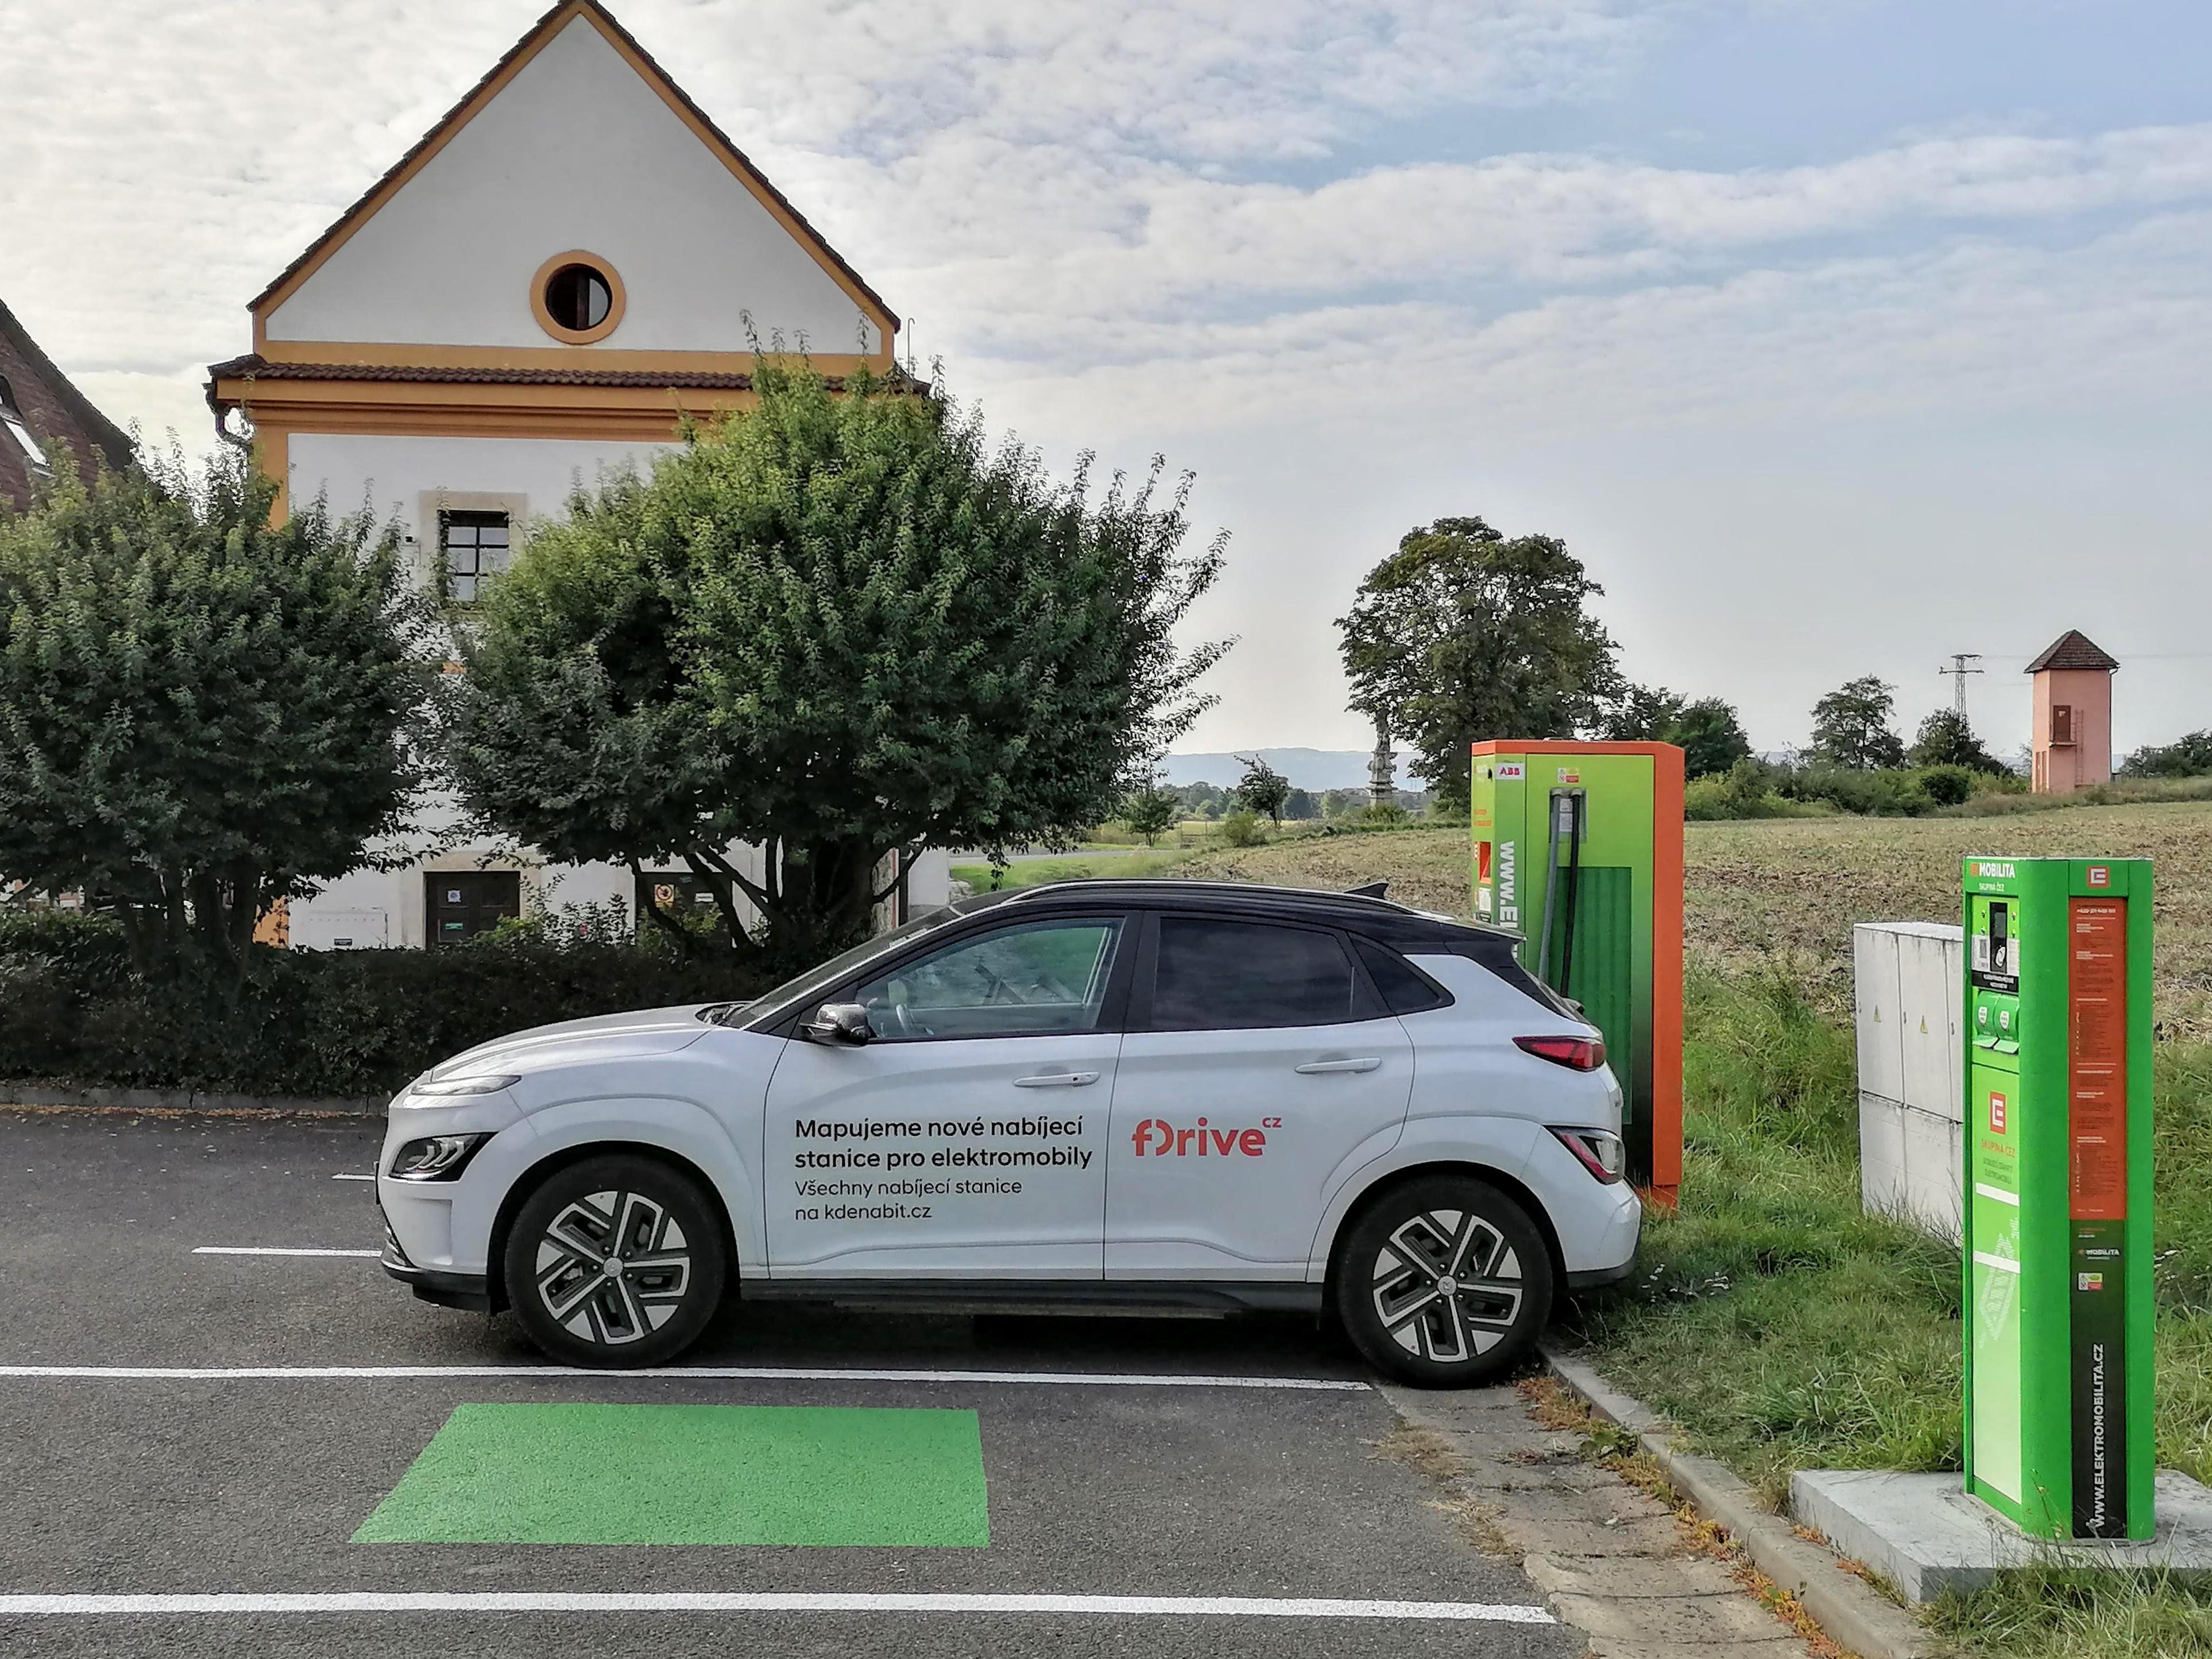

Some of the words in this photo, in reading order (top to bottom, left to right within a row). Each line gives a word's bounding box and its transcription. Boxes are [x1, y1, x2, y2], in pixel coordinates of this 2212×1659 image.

[1500, 767, 1521, 775] ABB
[1979, 863, 2016, 879] MOBILITA
[795, 1117, 922, 1142] Mapujeme
[929, 1116, 985, 1136] nové
[991, 1115, 1083, 1139] nabíjecí
[795, 1148, 881, 1168] stanice
[887, 1153, 925, 1171] pro
[931, 1146, 1093, 1170] elektromobily
[795, 1179, 873, 1198] Všechny
[877, 1178, 951, 1198] nabíjecí
[955, 1178, 1022, 1194] stanice
[795, 1208, 819, 1220] na
[825, 1203, 933, 1220] kdenabit.cz
[2093, 1343, 2105, 1527] WWW.ELEKTROMOBILITA.CZ
